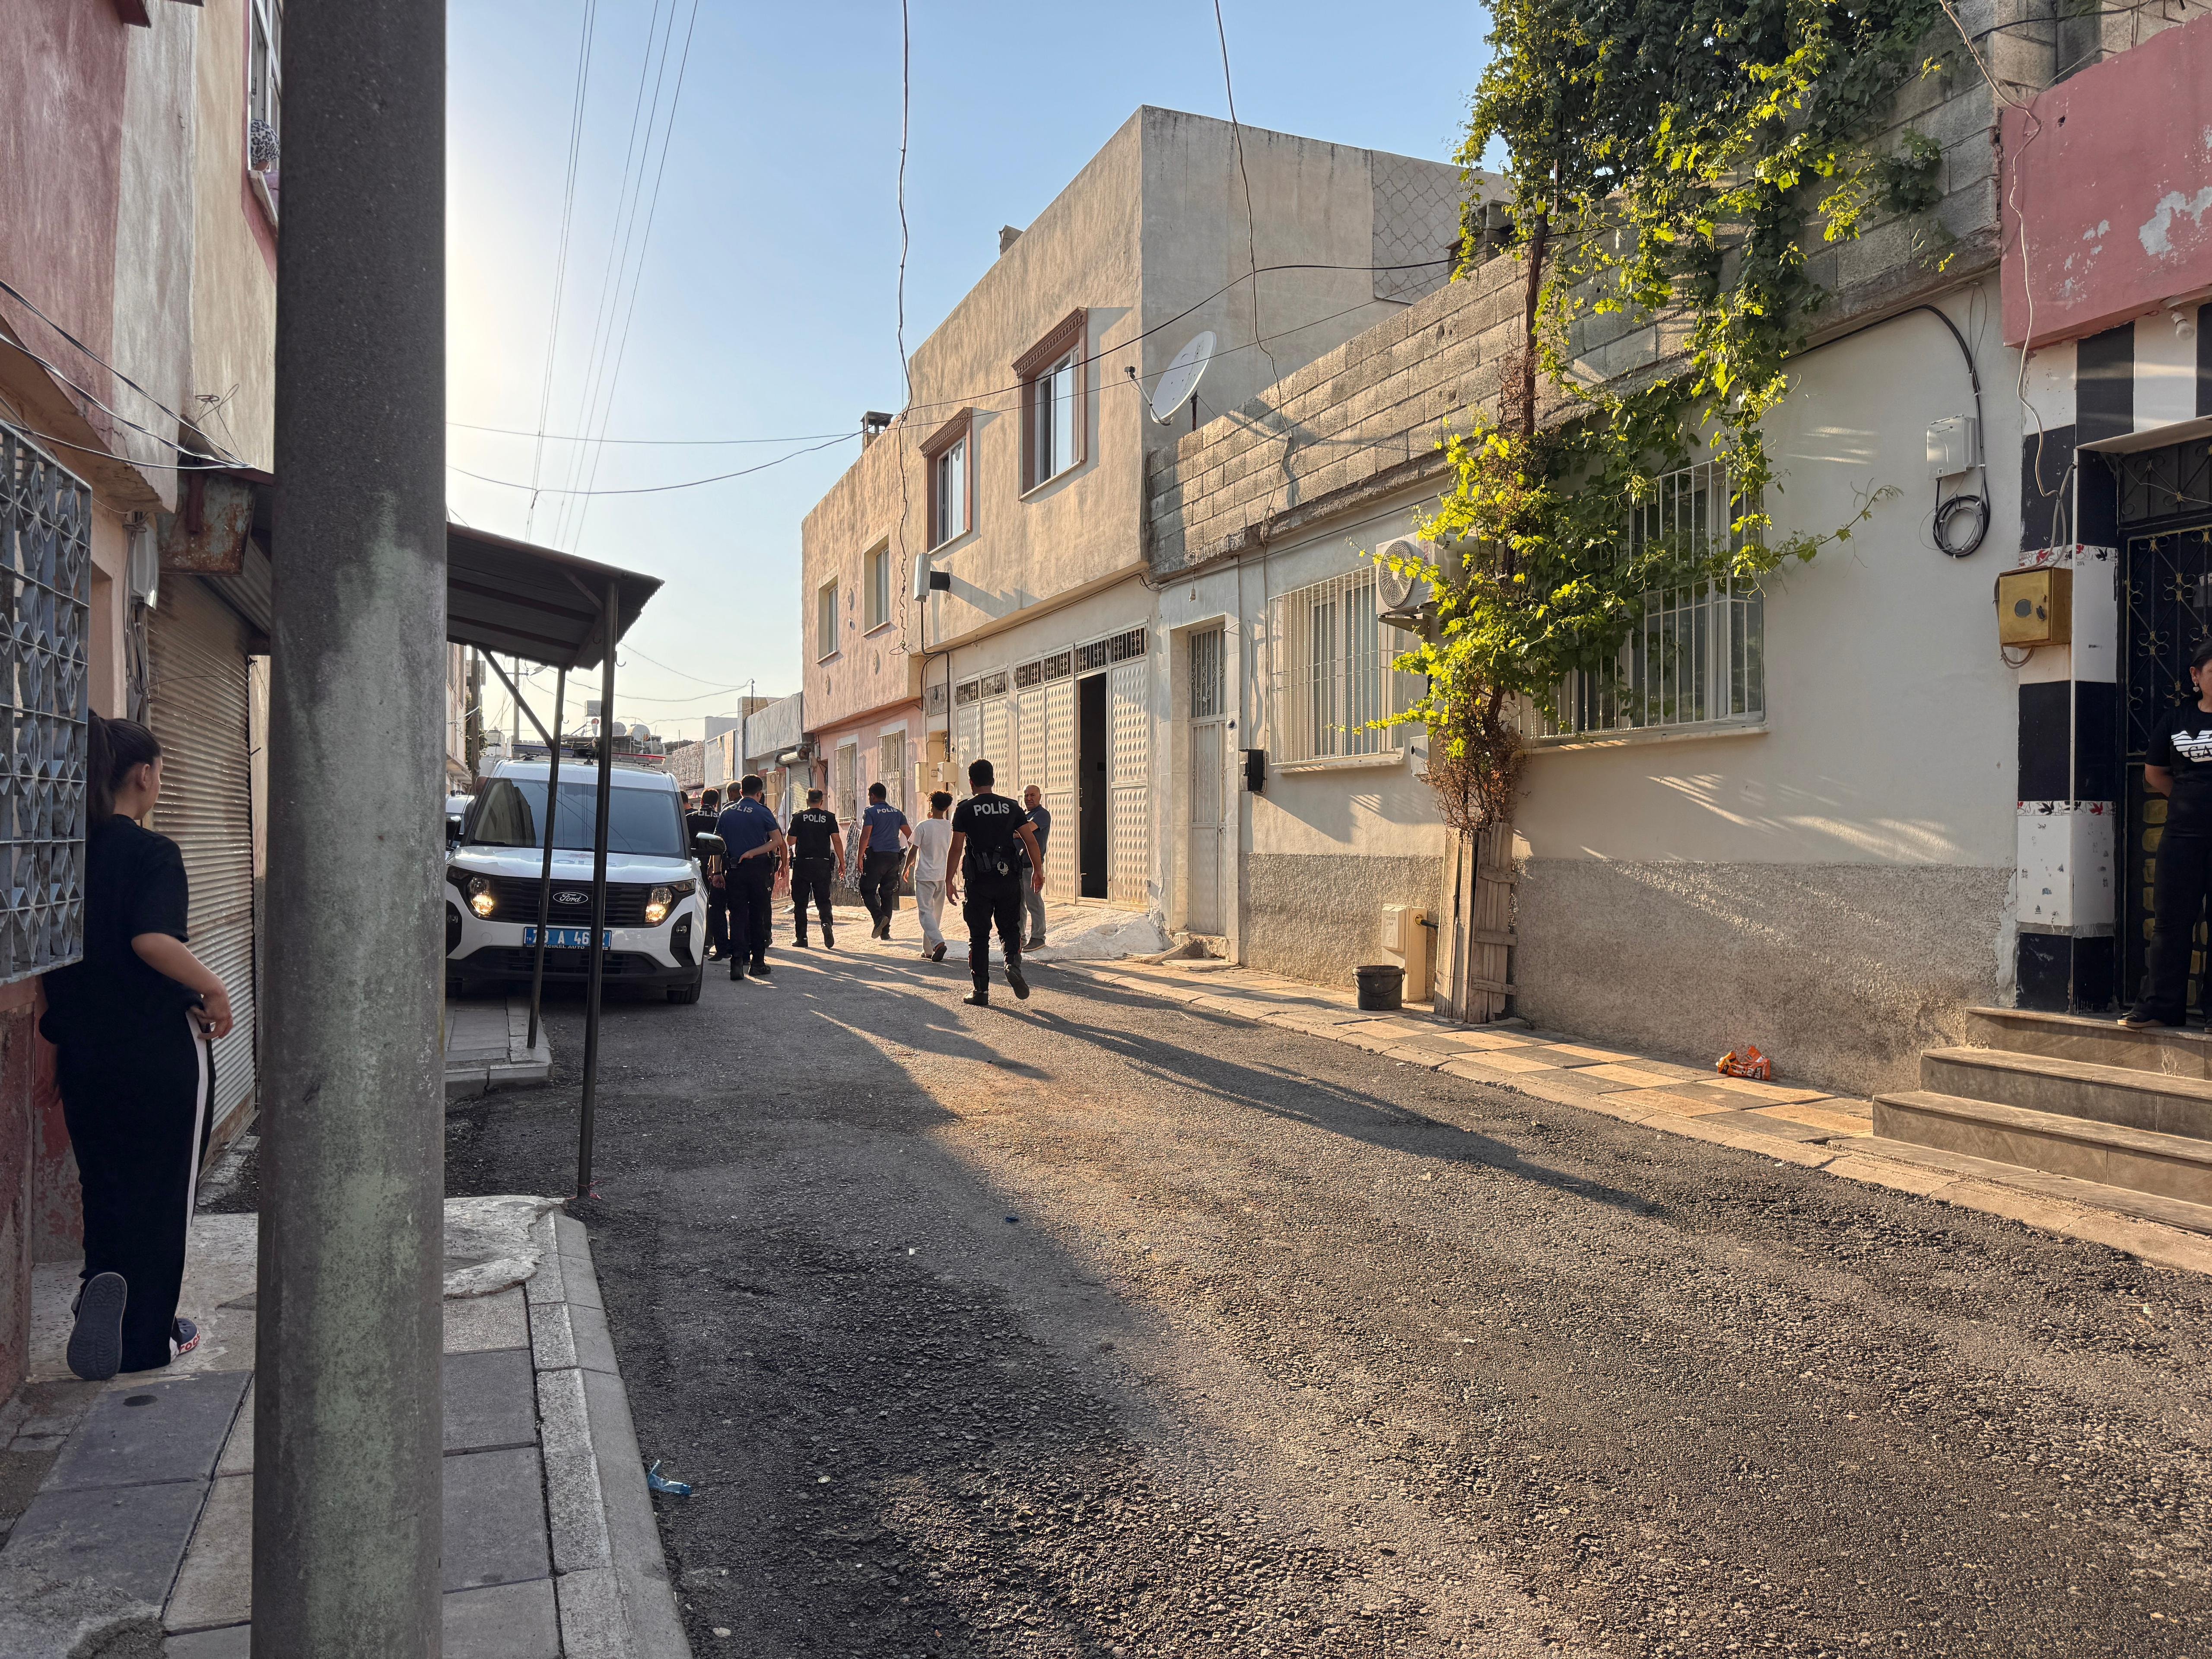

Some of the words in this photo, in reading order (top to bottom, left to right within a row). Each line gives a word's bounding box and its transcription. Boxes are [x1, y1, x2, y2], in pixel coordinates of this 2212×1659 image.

[726, 804, 753, 813] OLİS
[973, 801, 1010, 816] POLİS
[559, 893, 582, 903] Ford
[557, 931, 565, 944] A
[179, 1333, 200, 1353] rocs
